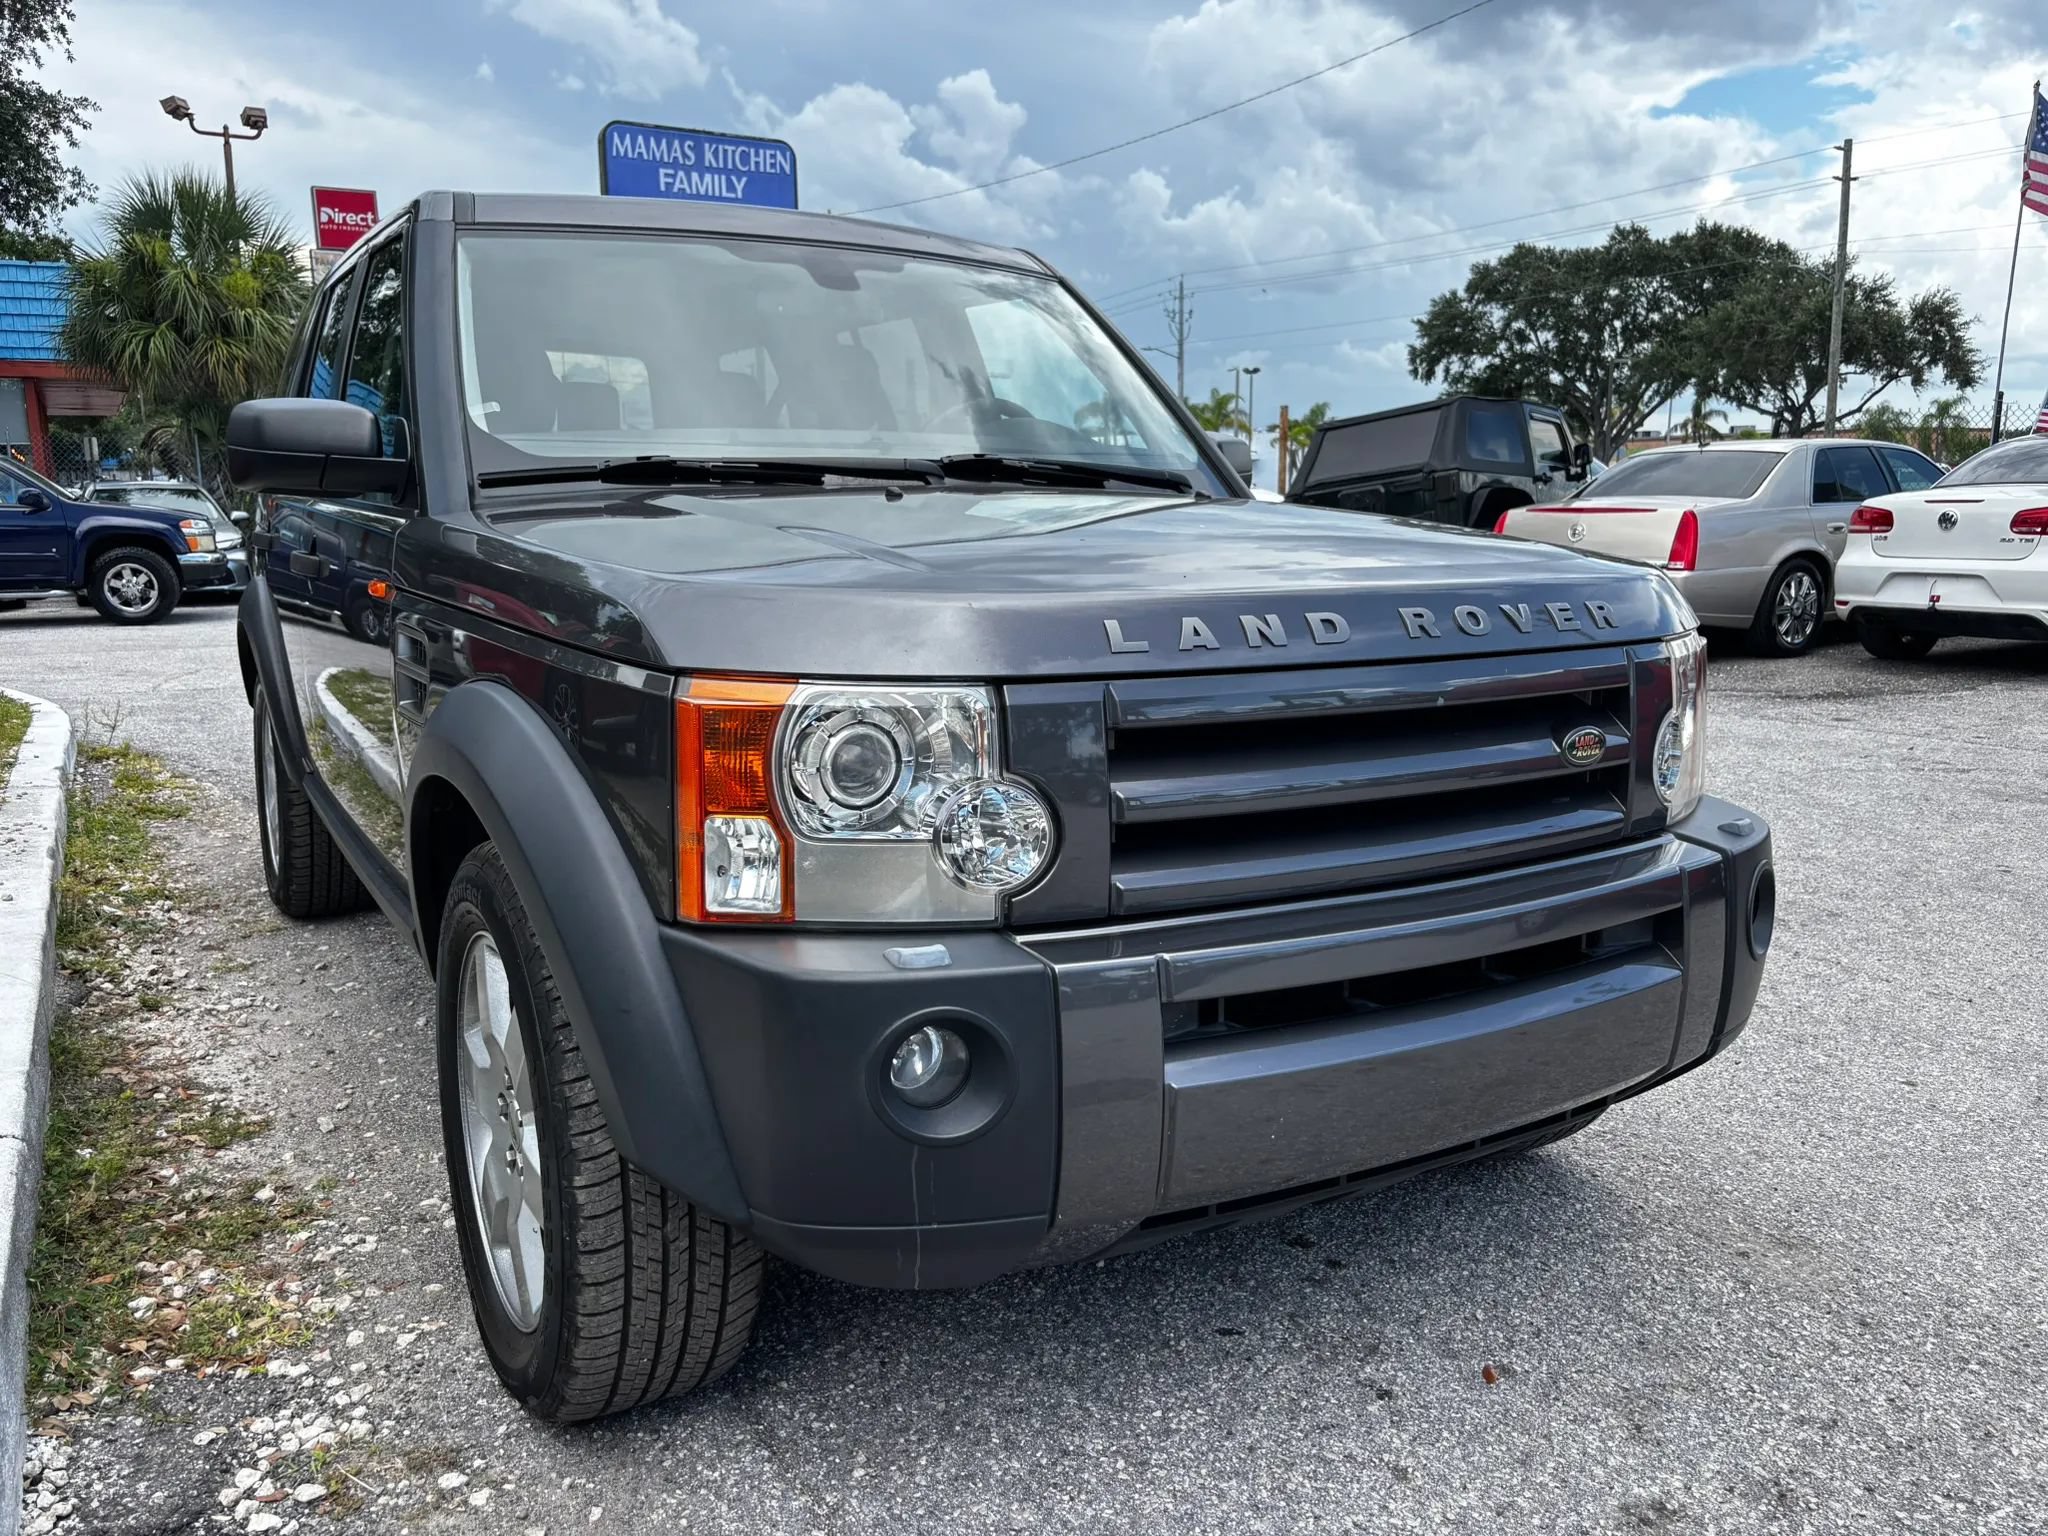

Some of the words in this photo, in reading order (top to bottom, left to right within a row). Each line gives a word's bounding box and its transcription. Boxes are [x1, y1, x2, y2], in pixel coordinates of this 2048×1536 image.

[612, 131, 696, 167] MAMAS
[703, 142, 792, 176] KITCHEN
[658, 167, 748, 199] FAMILY
[320, 207, 375, 226] Direct
[1103, 612, 1350, 653] LAND
[1398, 600, 1620, 639] ROVER
[1575, 735, 1595, 747] LAND
